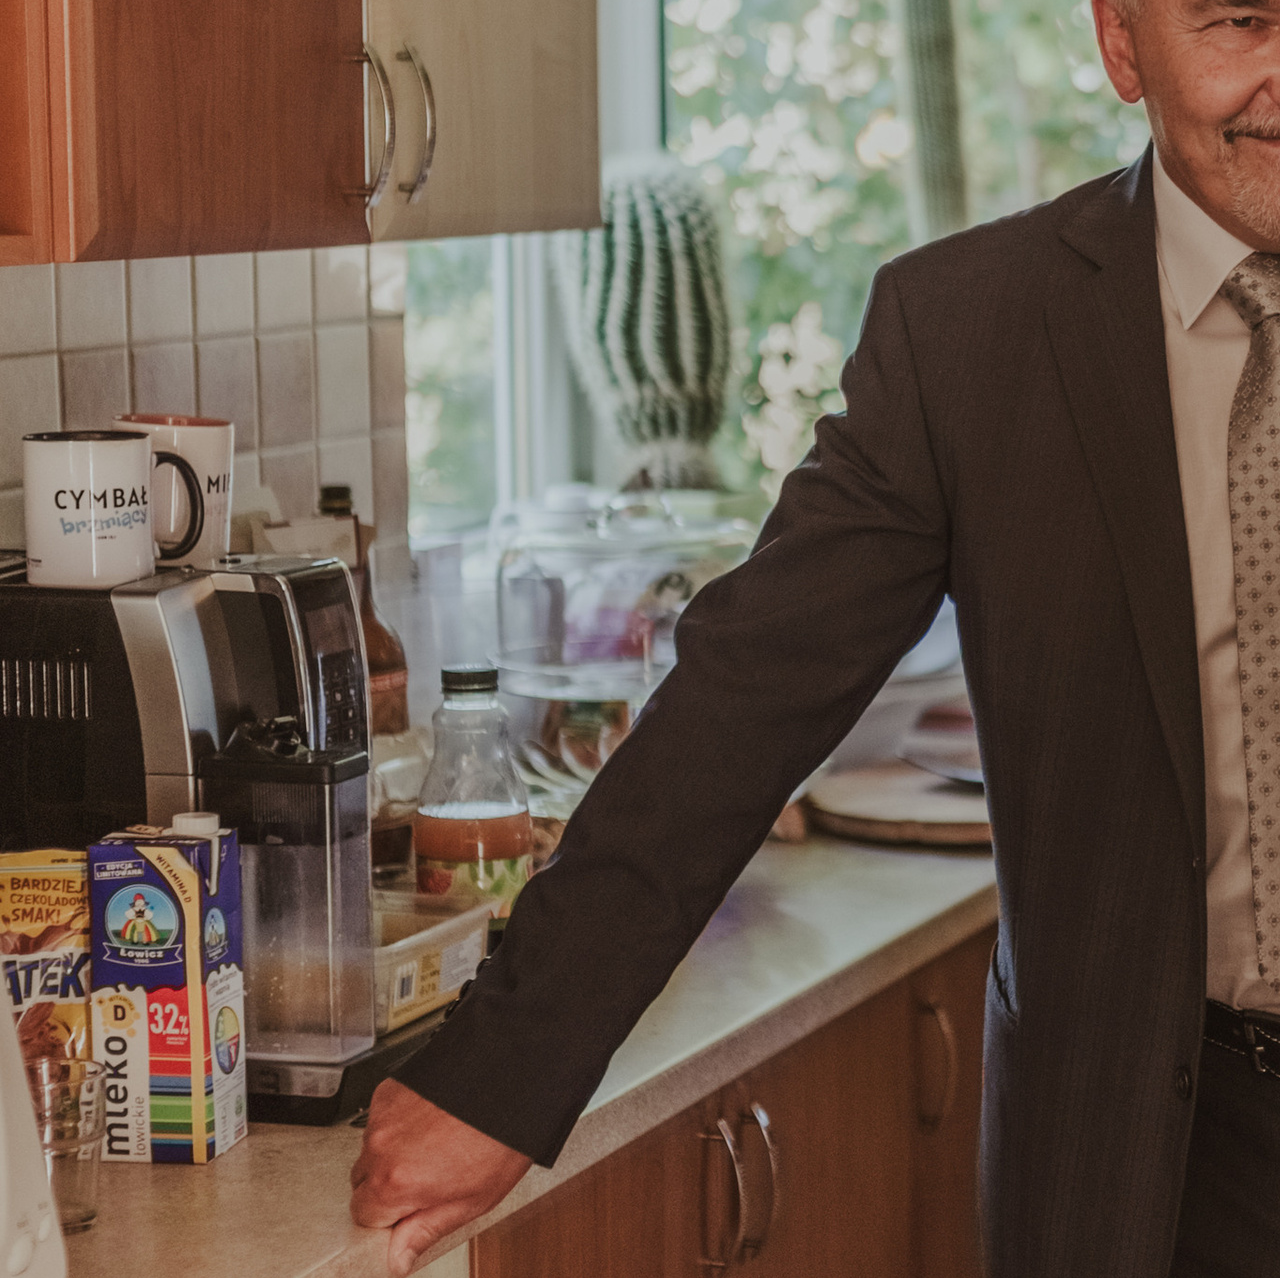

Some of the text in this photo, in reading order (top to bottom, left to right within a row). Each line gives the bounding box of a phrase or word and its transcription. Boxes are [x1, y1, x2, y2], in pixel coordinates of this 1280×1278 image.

[54, 485, 148, 510] CYMBAŁ
[60, 508, 147, 535] brzmiący
[106, 863, 133, 871] EDYCJA
[156, 853, 193, 904] WITAMINA D
[10, 877, 85, 894] BARDZIEJ
[12, 907, 61, 924] SMAK!
[120, 948, 164, 958] Łowicz
[113, 1005, 126, 1021] D
[149, 1002, 190, 1036] 3,2%
[104, 1035, 130, 1156] mleko
[131, 1096, 147, 1157] łowickie
